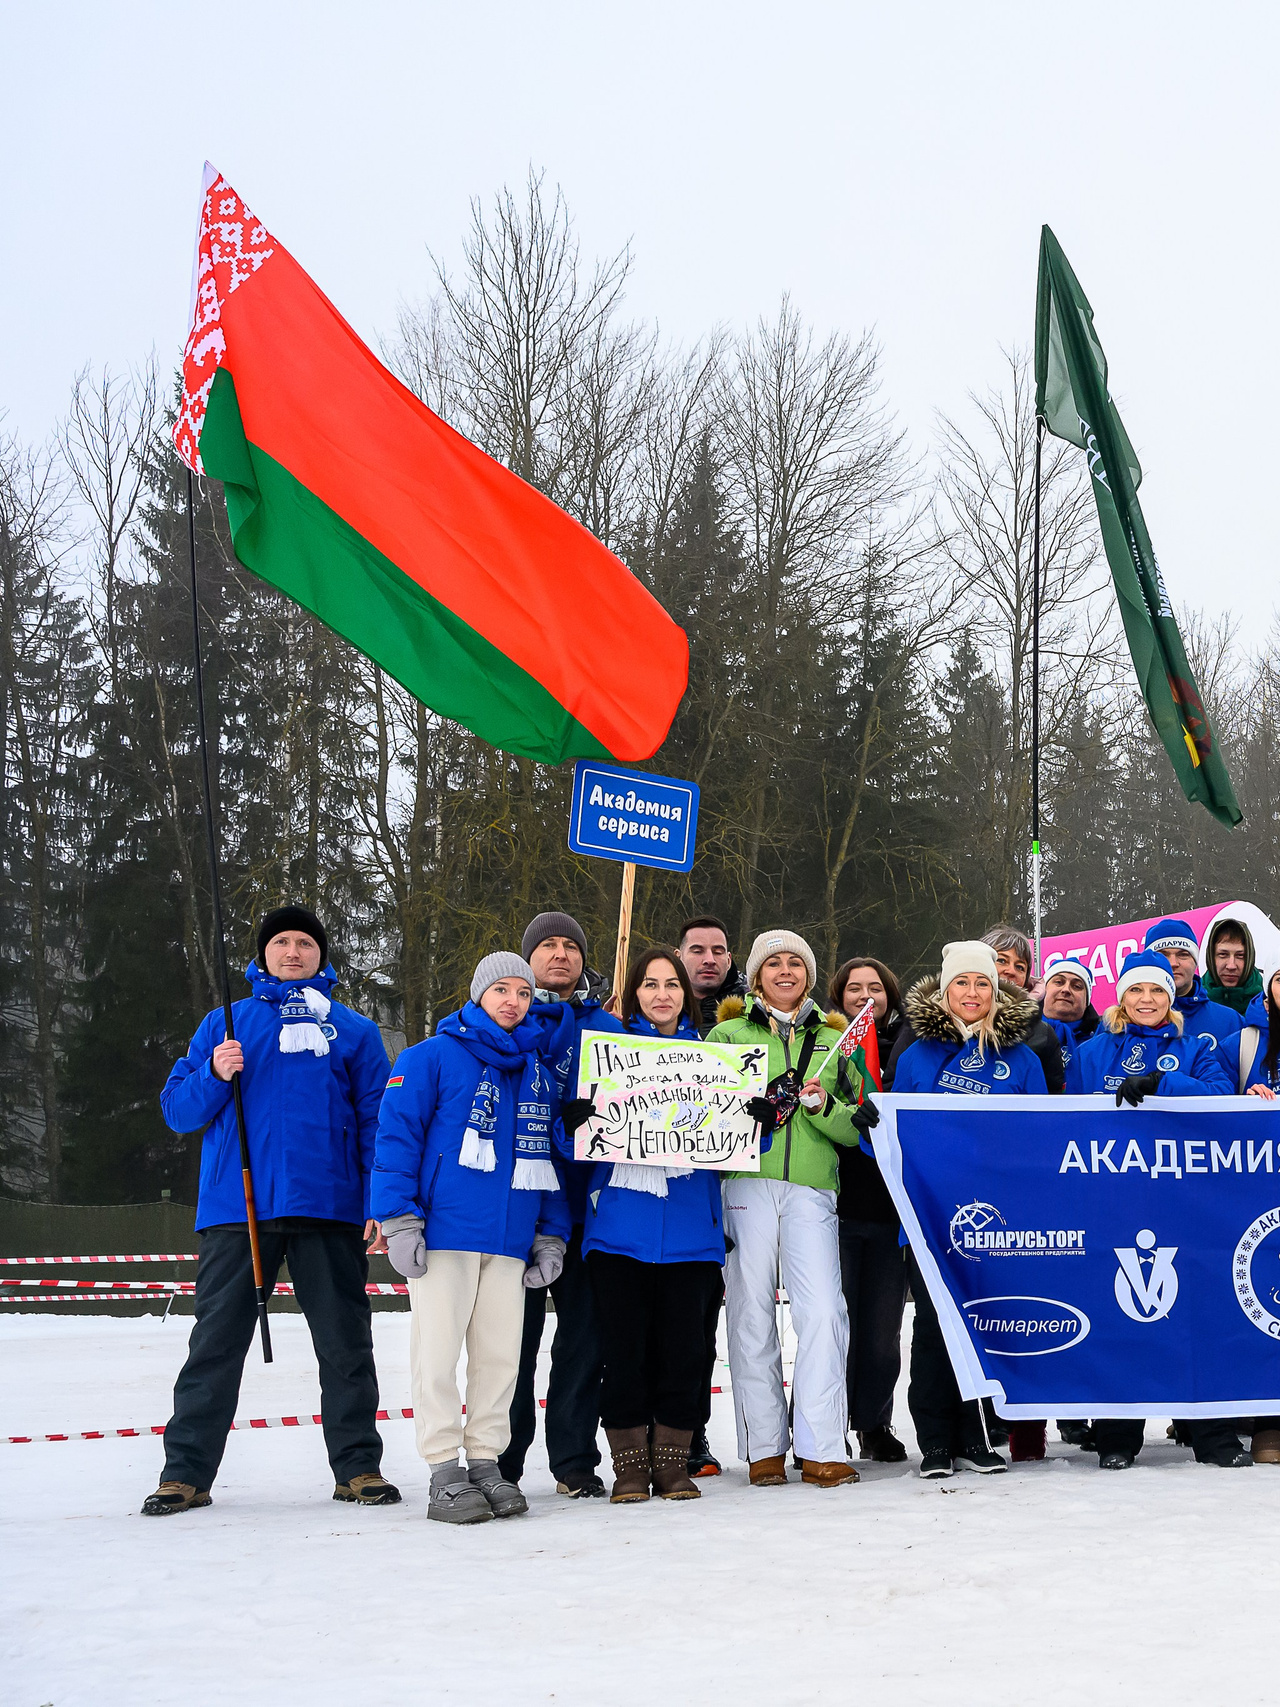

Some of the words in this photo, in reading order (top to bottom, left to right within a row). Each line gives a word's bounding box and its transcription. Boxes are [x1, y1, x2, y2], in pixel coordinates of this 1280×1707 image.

[589, 784, 683, 822] Академия
[598, 815, 670, 843] сервиса
[964, 1230, 1086, 1249] БЕЛАРУСЬТОРГ
